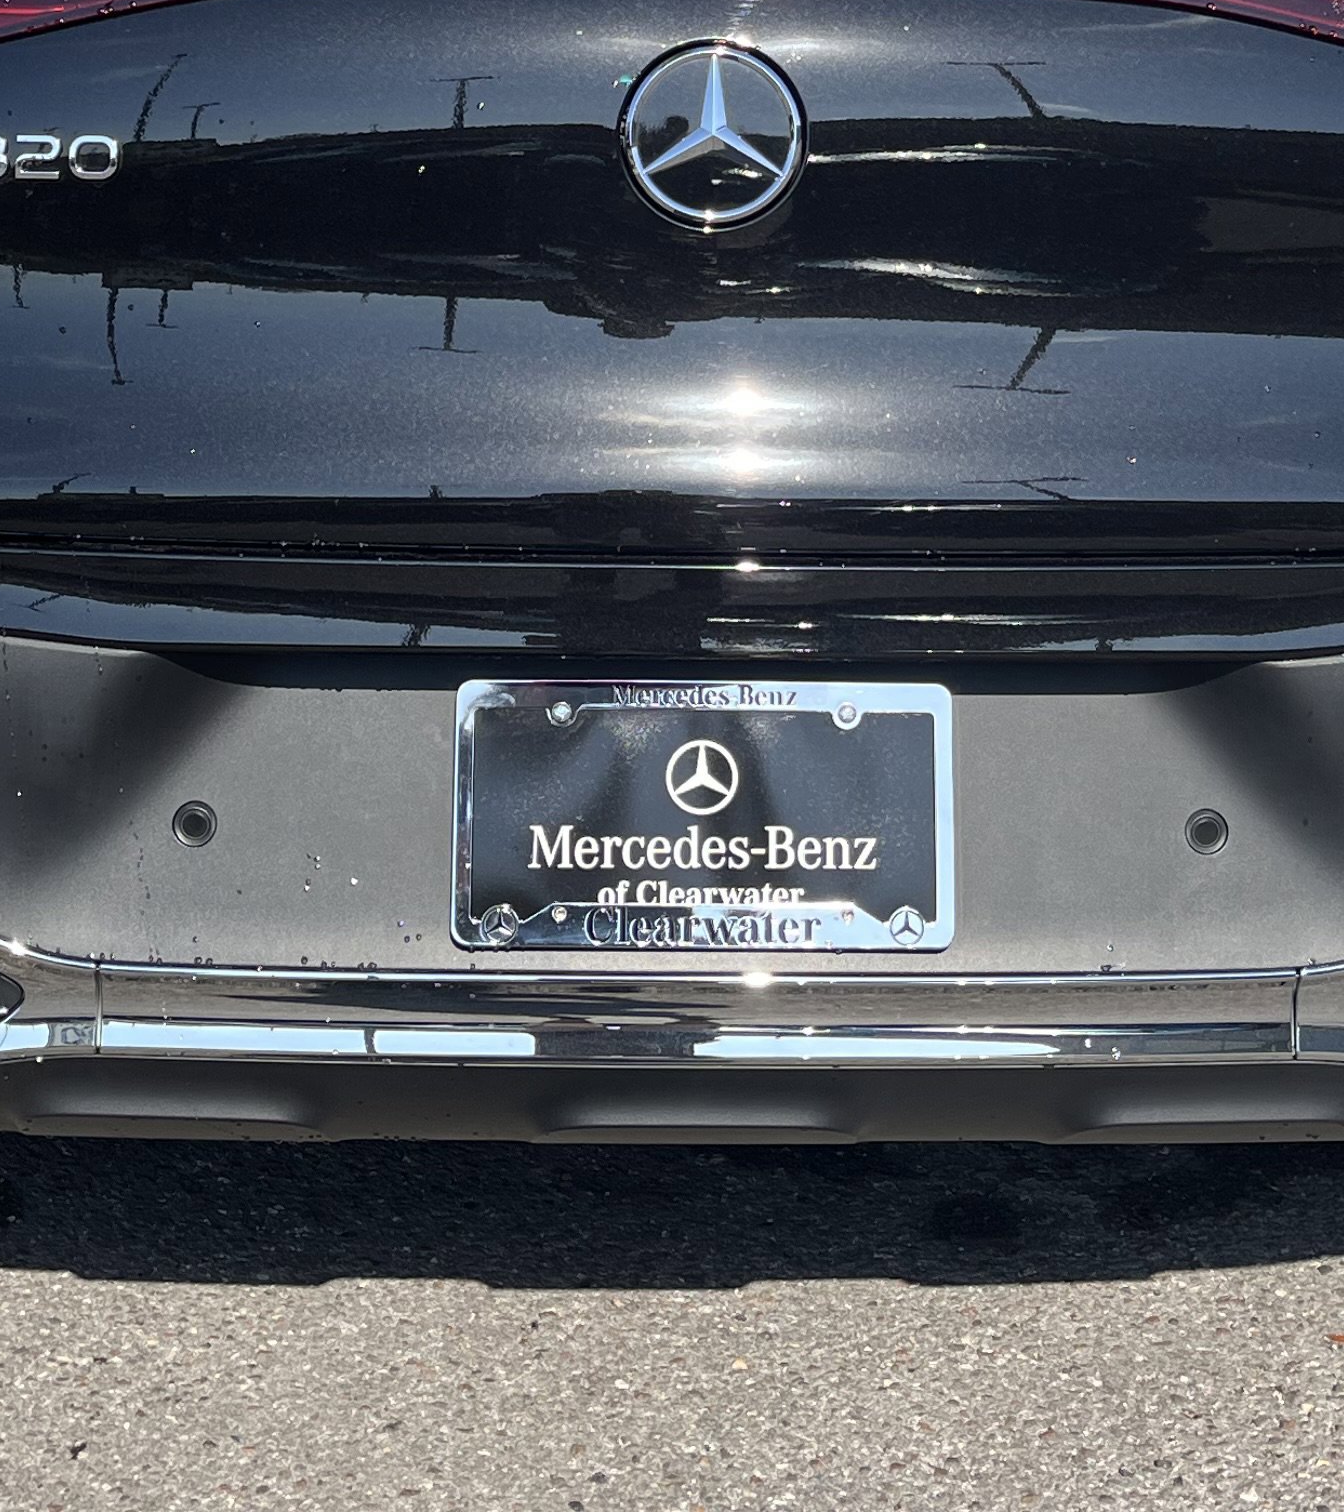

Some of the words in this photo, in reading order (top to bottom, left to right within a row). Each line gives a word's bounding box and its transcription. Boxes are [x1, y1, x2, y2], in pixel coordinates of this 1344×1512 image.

[527, 825, 878, 871] Mercedes-Benz
[596, 879, 631, 904] of
[635, 879, 806, 905] Clearwater
[583, 906, 822, 947] Clearwater
